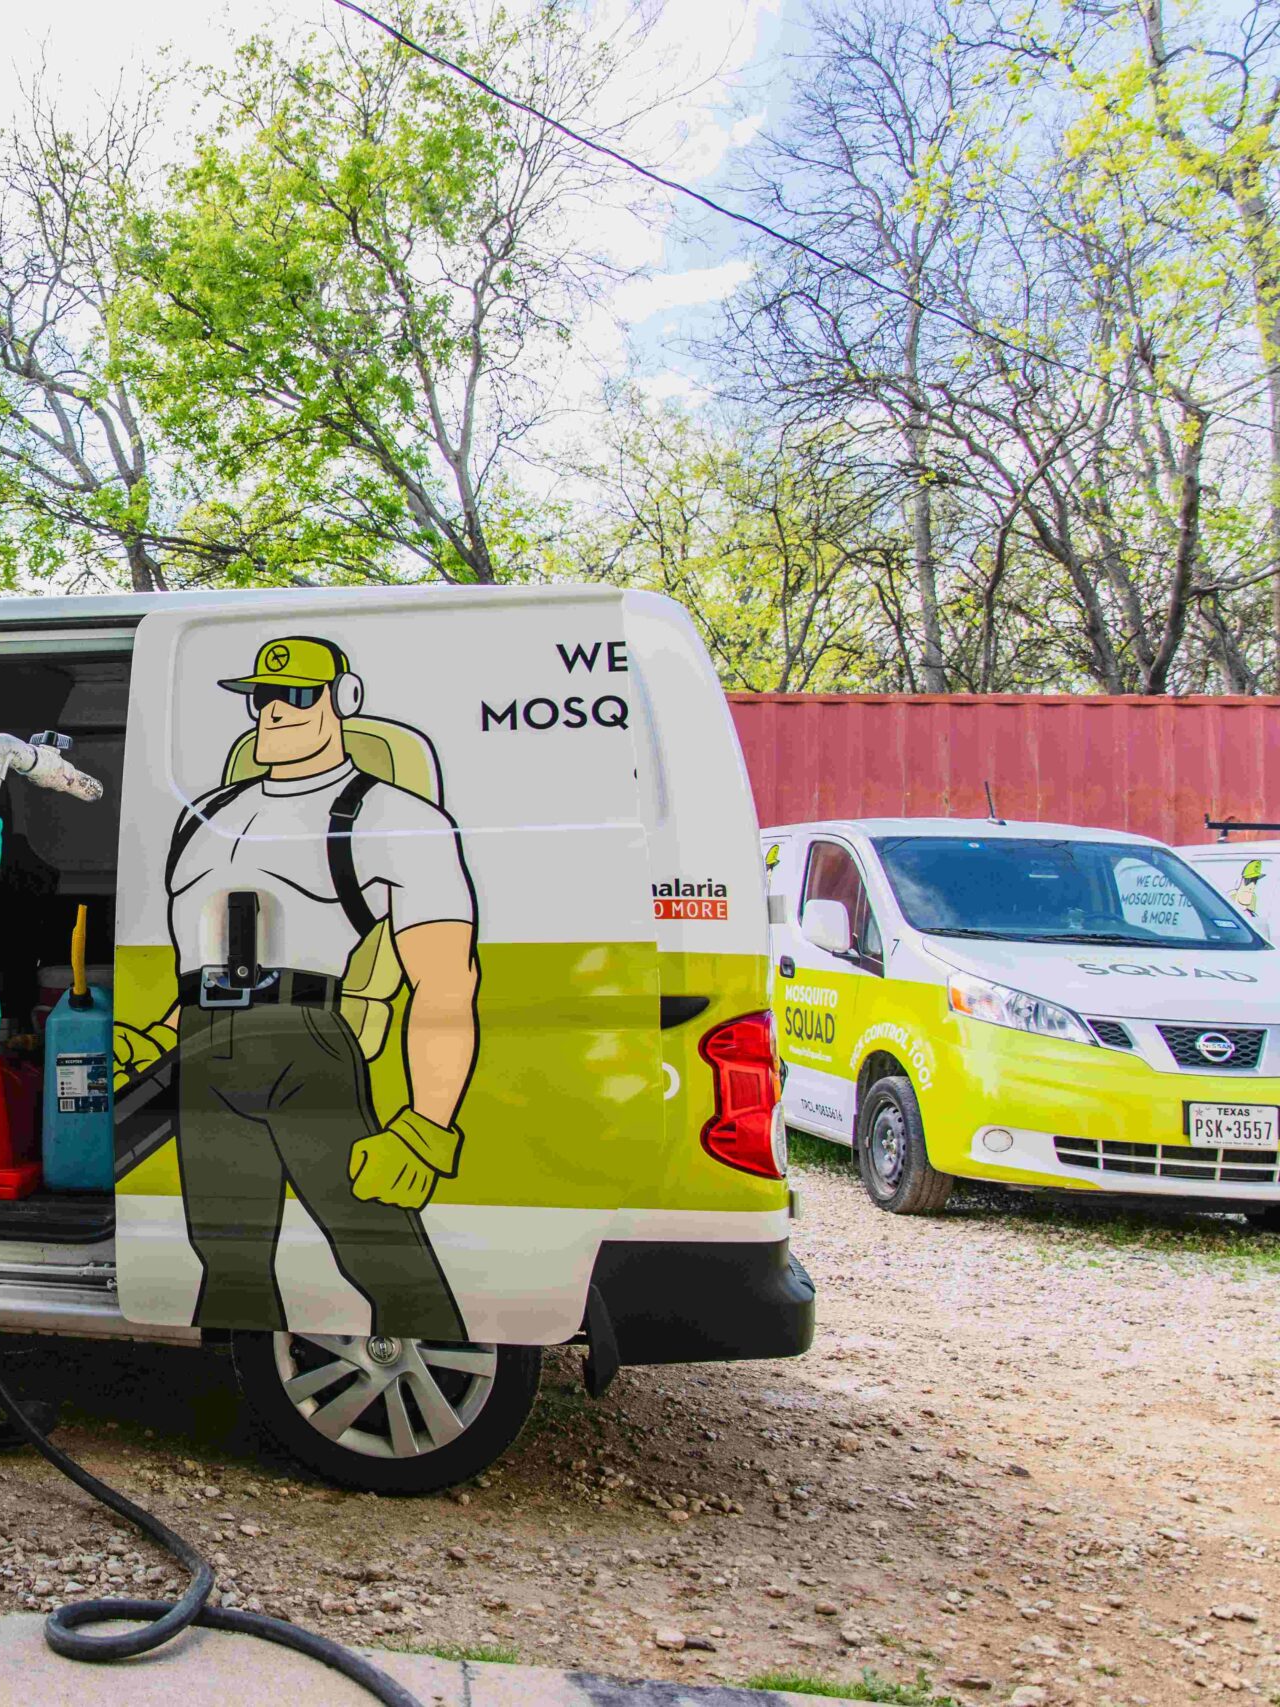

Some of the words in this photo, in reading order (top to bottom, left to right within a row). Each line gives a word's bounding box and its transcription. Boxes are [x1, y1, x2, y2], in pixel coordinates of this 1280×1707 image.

[555, 641, 629, 674] WE
[481, 694, 630, 731] MOSQ
[671, 901, 727, 919] MORE
[1140, 910, 1150, 924] &
[1150, 911, 1180, 926] MORE
[891, 938, 900, 956] 7
[1077, 963, 1258, 983] SQUAD
[785, 985, 838, 1008] MOSQUITO
[785, 1006, 836, 1044] SQUAD
[864, 1022, 909, 1050] CONTROL
[1216, 1107, 1250, 1117] TEXAS
